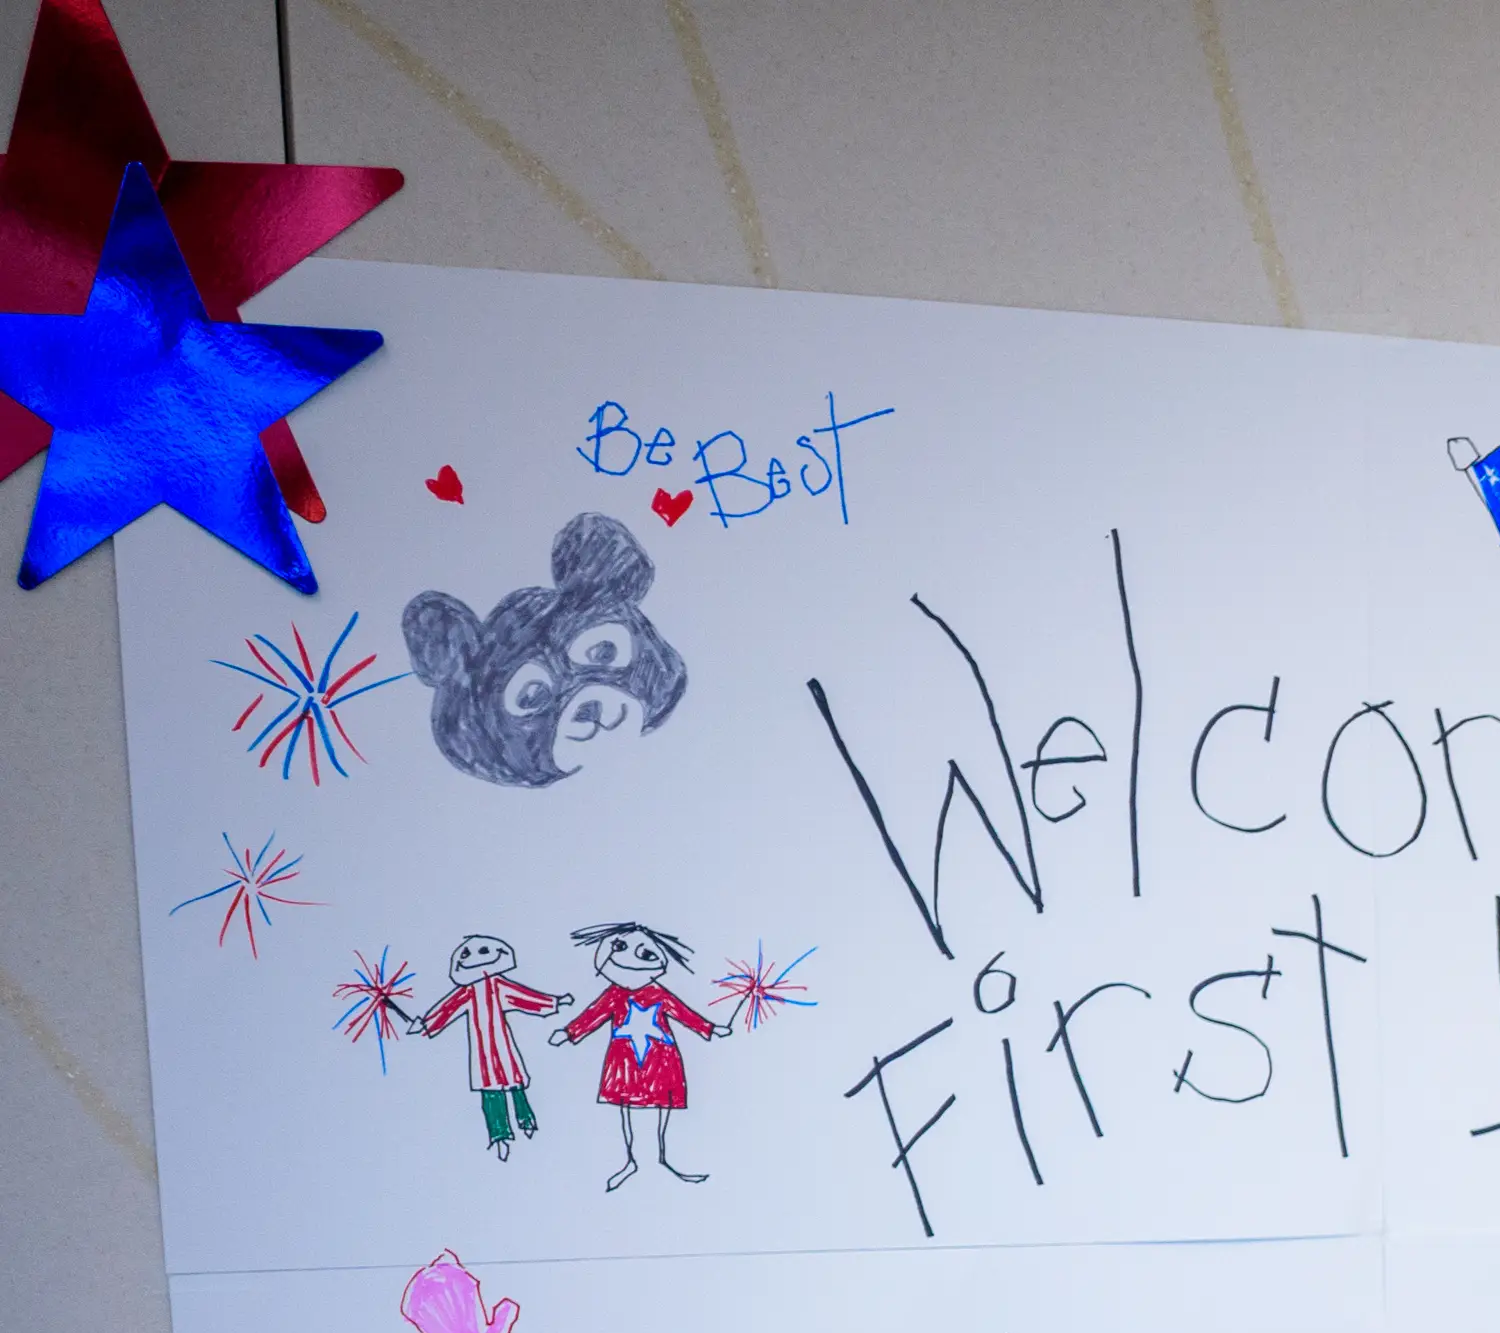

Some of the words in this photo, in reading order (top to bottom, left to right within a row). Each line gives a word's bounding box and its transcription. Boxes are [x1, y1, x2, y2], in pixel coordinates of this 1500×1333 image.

[577, 401, 675, 477] Be
[694, 391, 895, 527] Best
[844, 894, 1367, 1238] First
